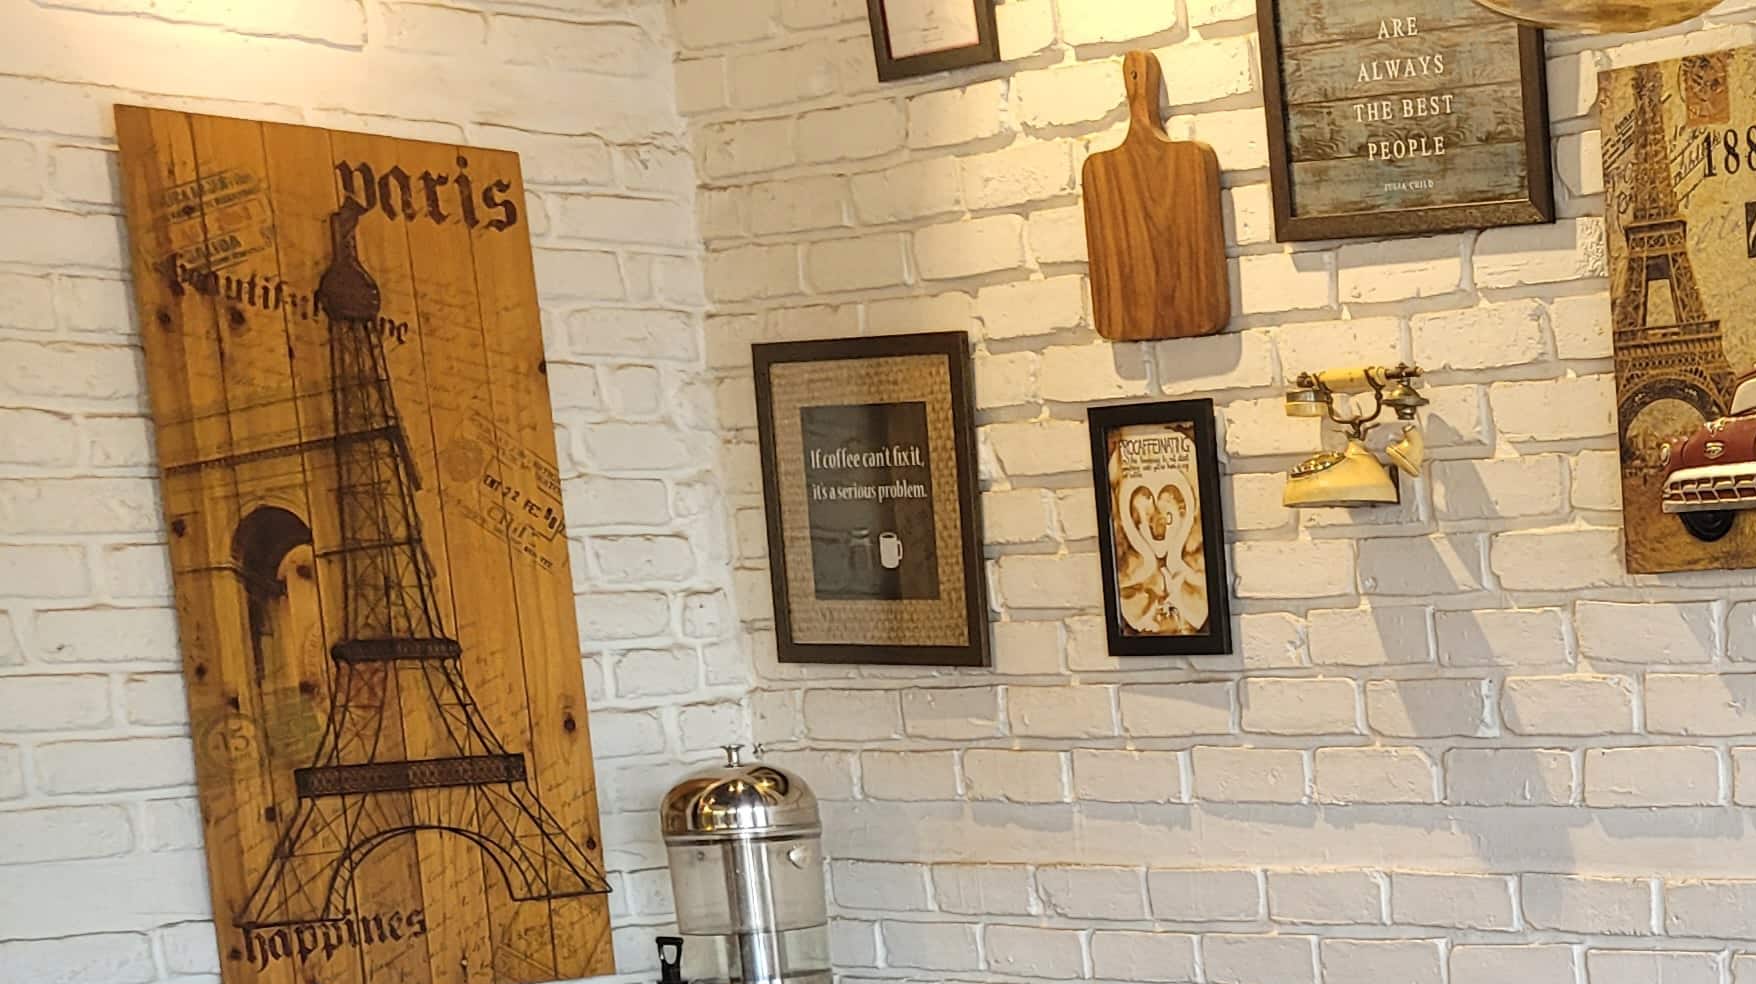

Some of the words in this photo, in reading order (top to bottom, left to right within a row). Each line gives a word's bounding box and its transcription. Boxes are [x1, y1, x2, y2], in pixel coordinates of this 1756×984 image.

[1378, 17, 1418, 39] ARE
[1358, 54, 1444, 82] ALWAYS
[1353, 101, 1393, 122] THE
[1402, 95, 1453, 118] BEST
[1368, 136, 1446, 161] PEOPLE
[810, 449, 821, 469] If
[822, 447, 860, 469] coffee
[862, 446, 892, 468] can't
[893, 445, 910, 467] fix
[829, 486, 836, 500] a
[837, 482, 876, 500] serious
[878, 480, 928, 503] problem.
